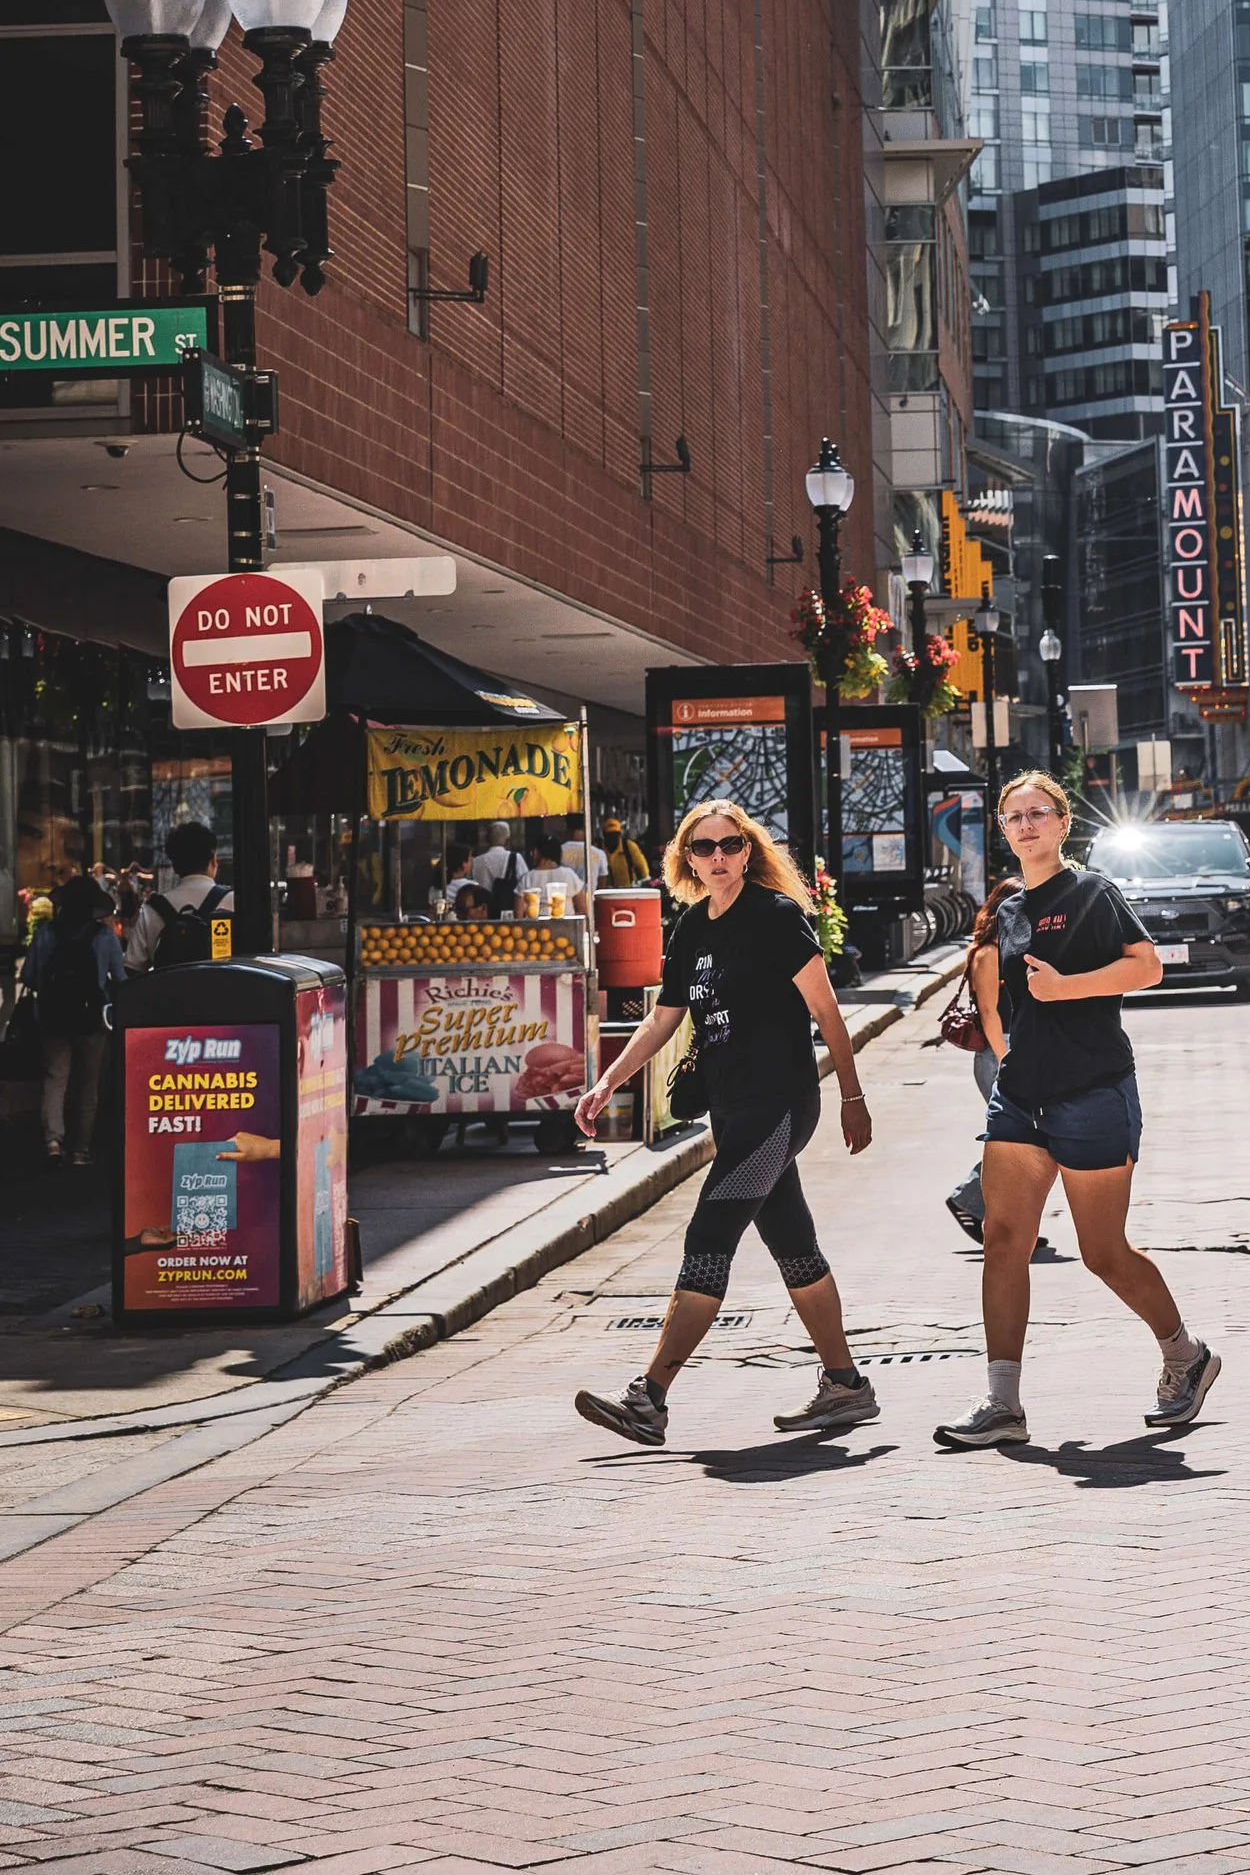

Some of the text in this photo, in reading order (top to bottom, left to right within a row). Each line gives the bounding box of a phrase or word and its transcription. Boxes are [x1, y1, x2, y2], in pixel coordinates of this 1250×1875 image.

[0, 317, 156, 362] SUMMER
[1169, 330, 1205, 680] PARAMOUNT
[197, 603, 293, 631] DO NOT
[209, 668, 288, 694] ENTER
[384, 732, 448, 757] Fresh
[381, 742, 572, 817] LEMONADE
[424, 978, 515, 1005] Richie's
[419, 1001, 519, 1036] Super
[203, 1038, 242, 1060] Run
[394, 1020, 549, 1063] Premium
[419, 1055, 522, 1076] ITALIAN
[148, 1072, 258, 1091] CANNABIS
[448, 1075, 490, 1094] ICE
[148, 1092, 256, 1112] DELIVERED
[148, 1116, 202, 1134] FAST!
[204, 1174, 228, 1188] Run
[157, 1255, 248, 1267] ORDER NOW AT
[157, 1269, 248, 1282] ZYPRUN.COM
